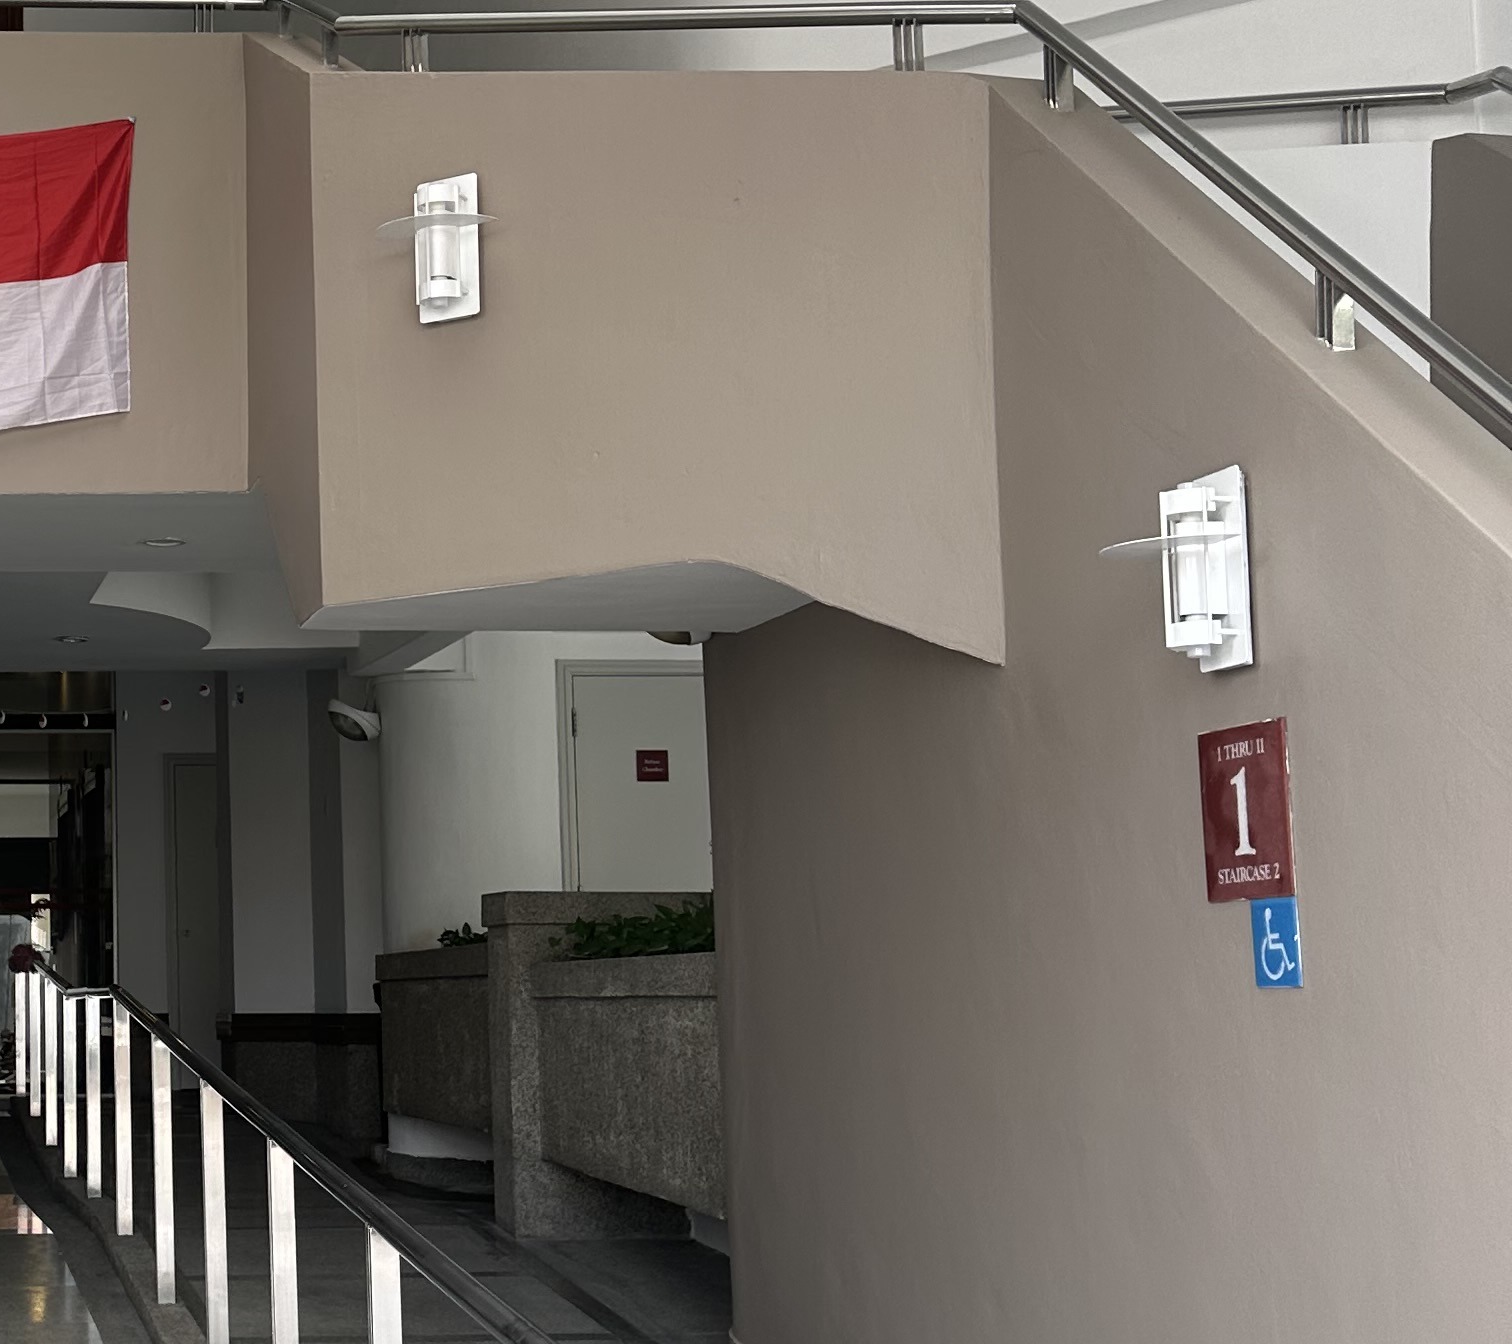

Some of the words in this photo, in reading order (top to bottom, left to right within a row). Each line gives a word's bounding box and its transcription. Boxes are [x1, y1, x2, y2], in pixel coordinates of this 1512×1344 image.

[1223, 740, 1254, 760] THRU
[1230, 766, 1256, 856] 1
[1218, 864, 1272, 885] STAIRCASE
[1273, 862, 1280, 879] 2
